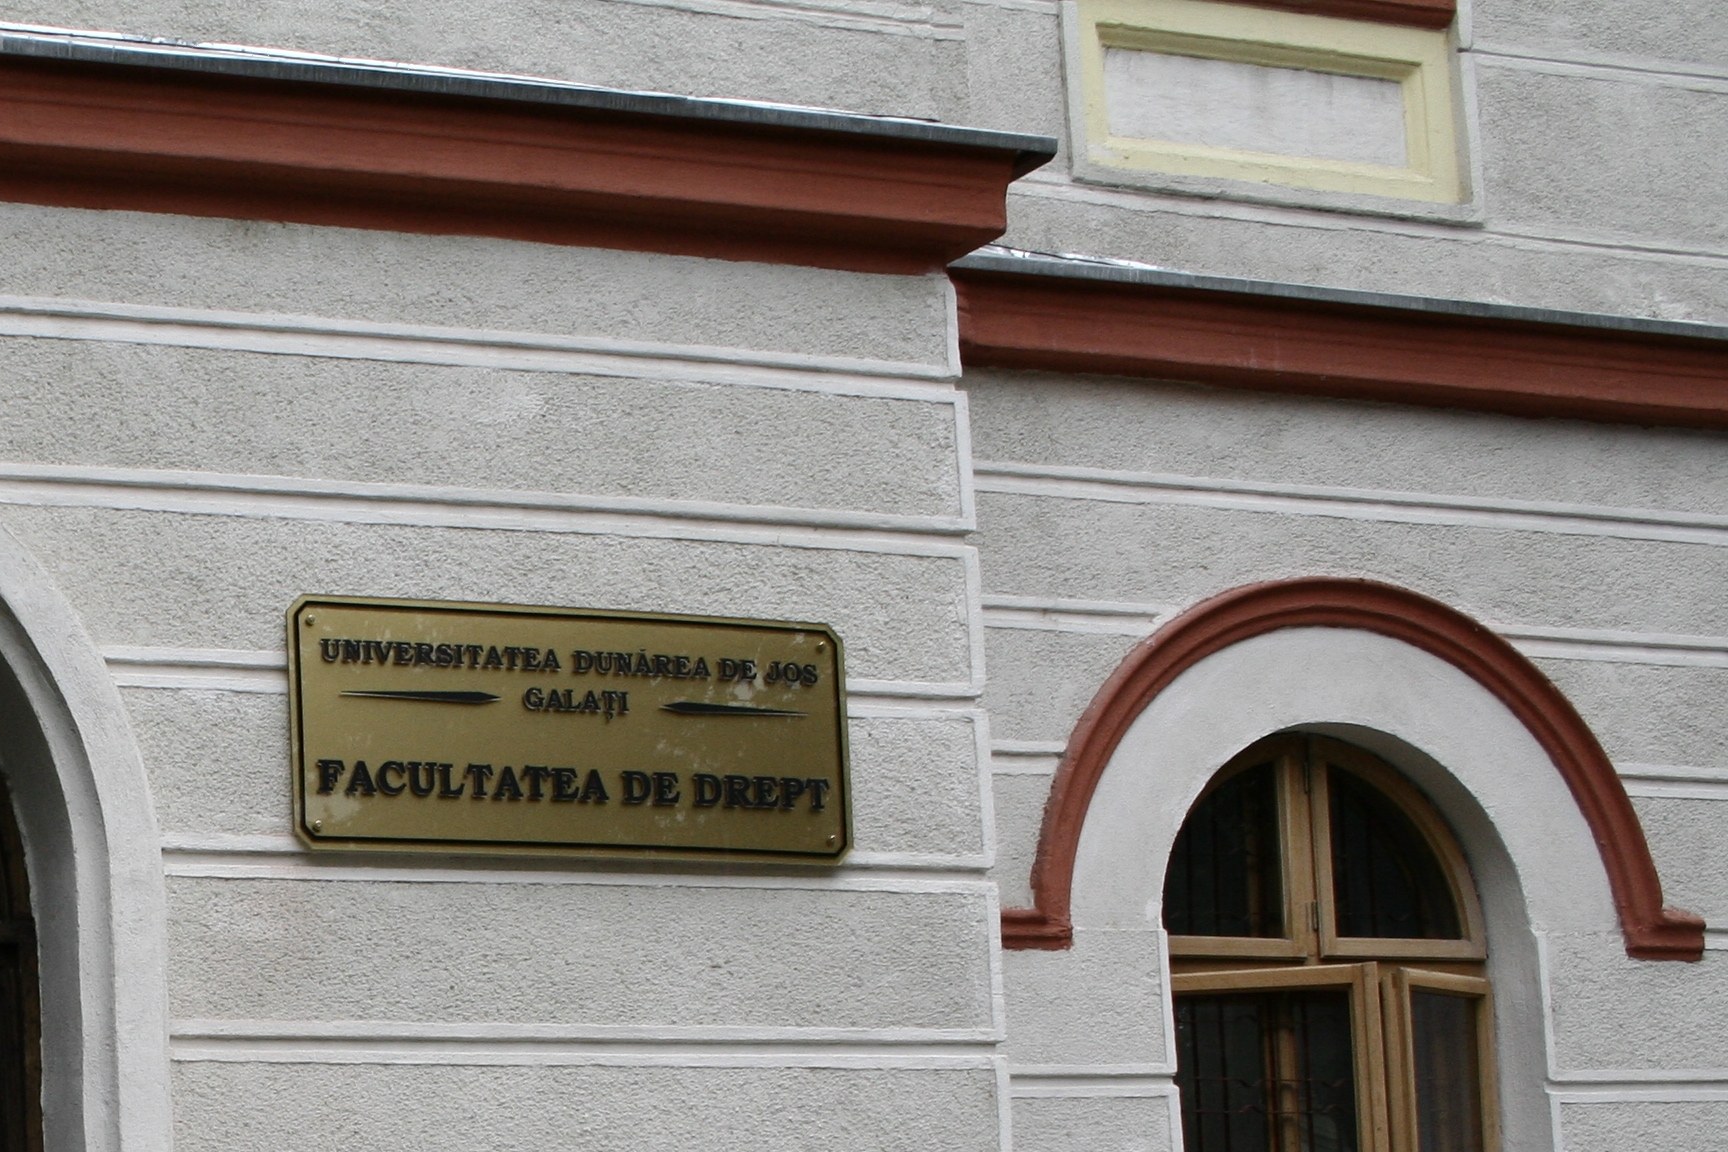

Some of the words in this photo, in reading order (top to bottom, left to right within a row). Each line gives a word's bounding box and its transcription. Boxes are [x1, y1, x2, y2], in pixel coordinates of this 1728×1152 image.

[320, 638, 562, 673] UNIVERSITATEA
[571, 648, 711, 678] DUNĂREA
[718, 657, 758, 682] DE
[765, 660, 819, 686] JOS
[316, 758, 610, 803] FACULTATEA
[622, 770, 682, 806] DE
[692, 772, 830, 811] DREPT
